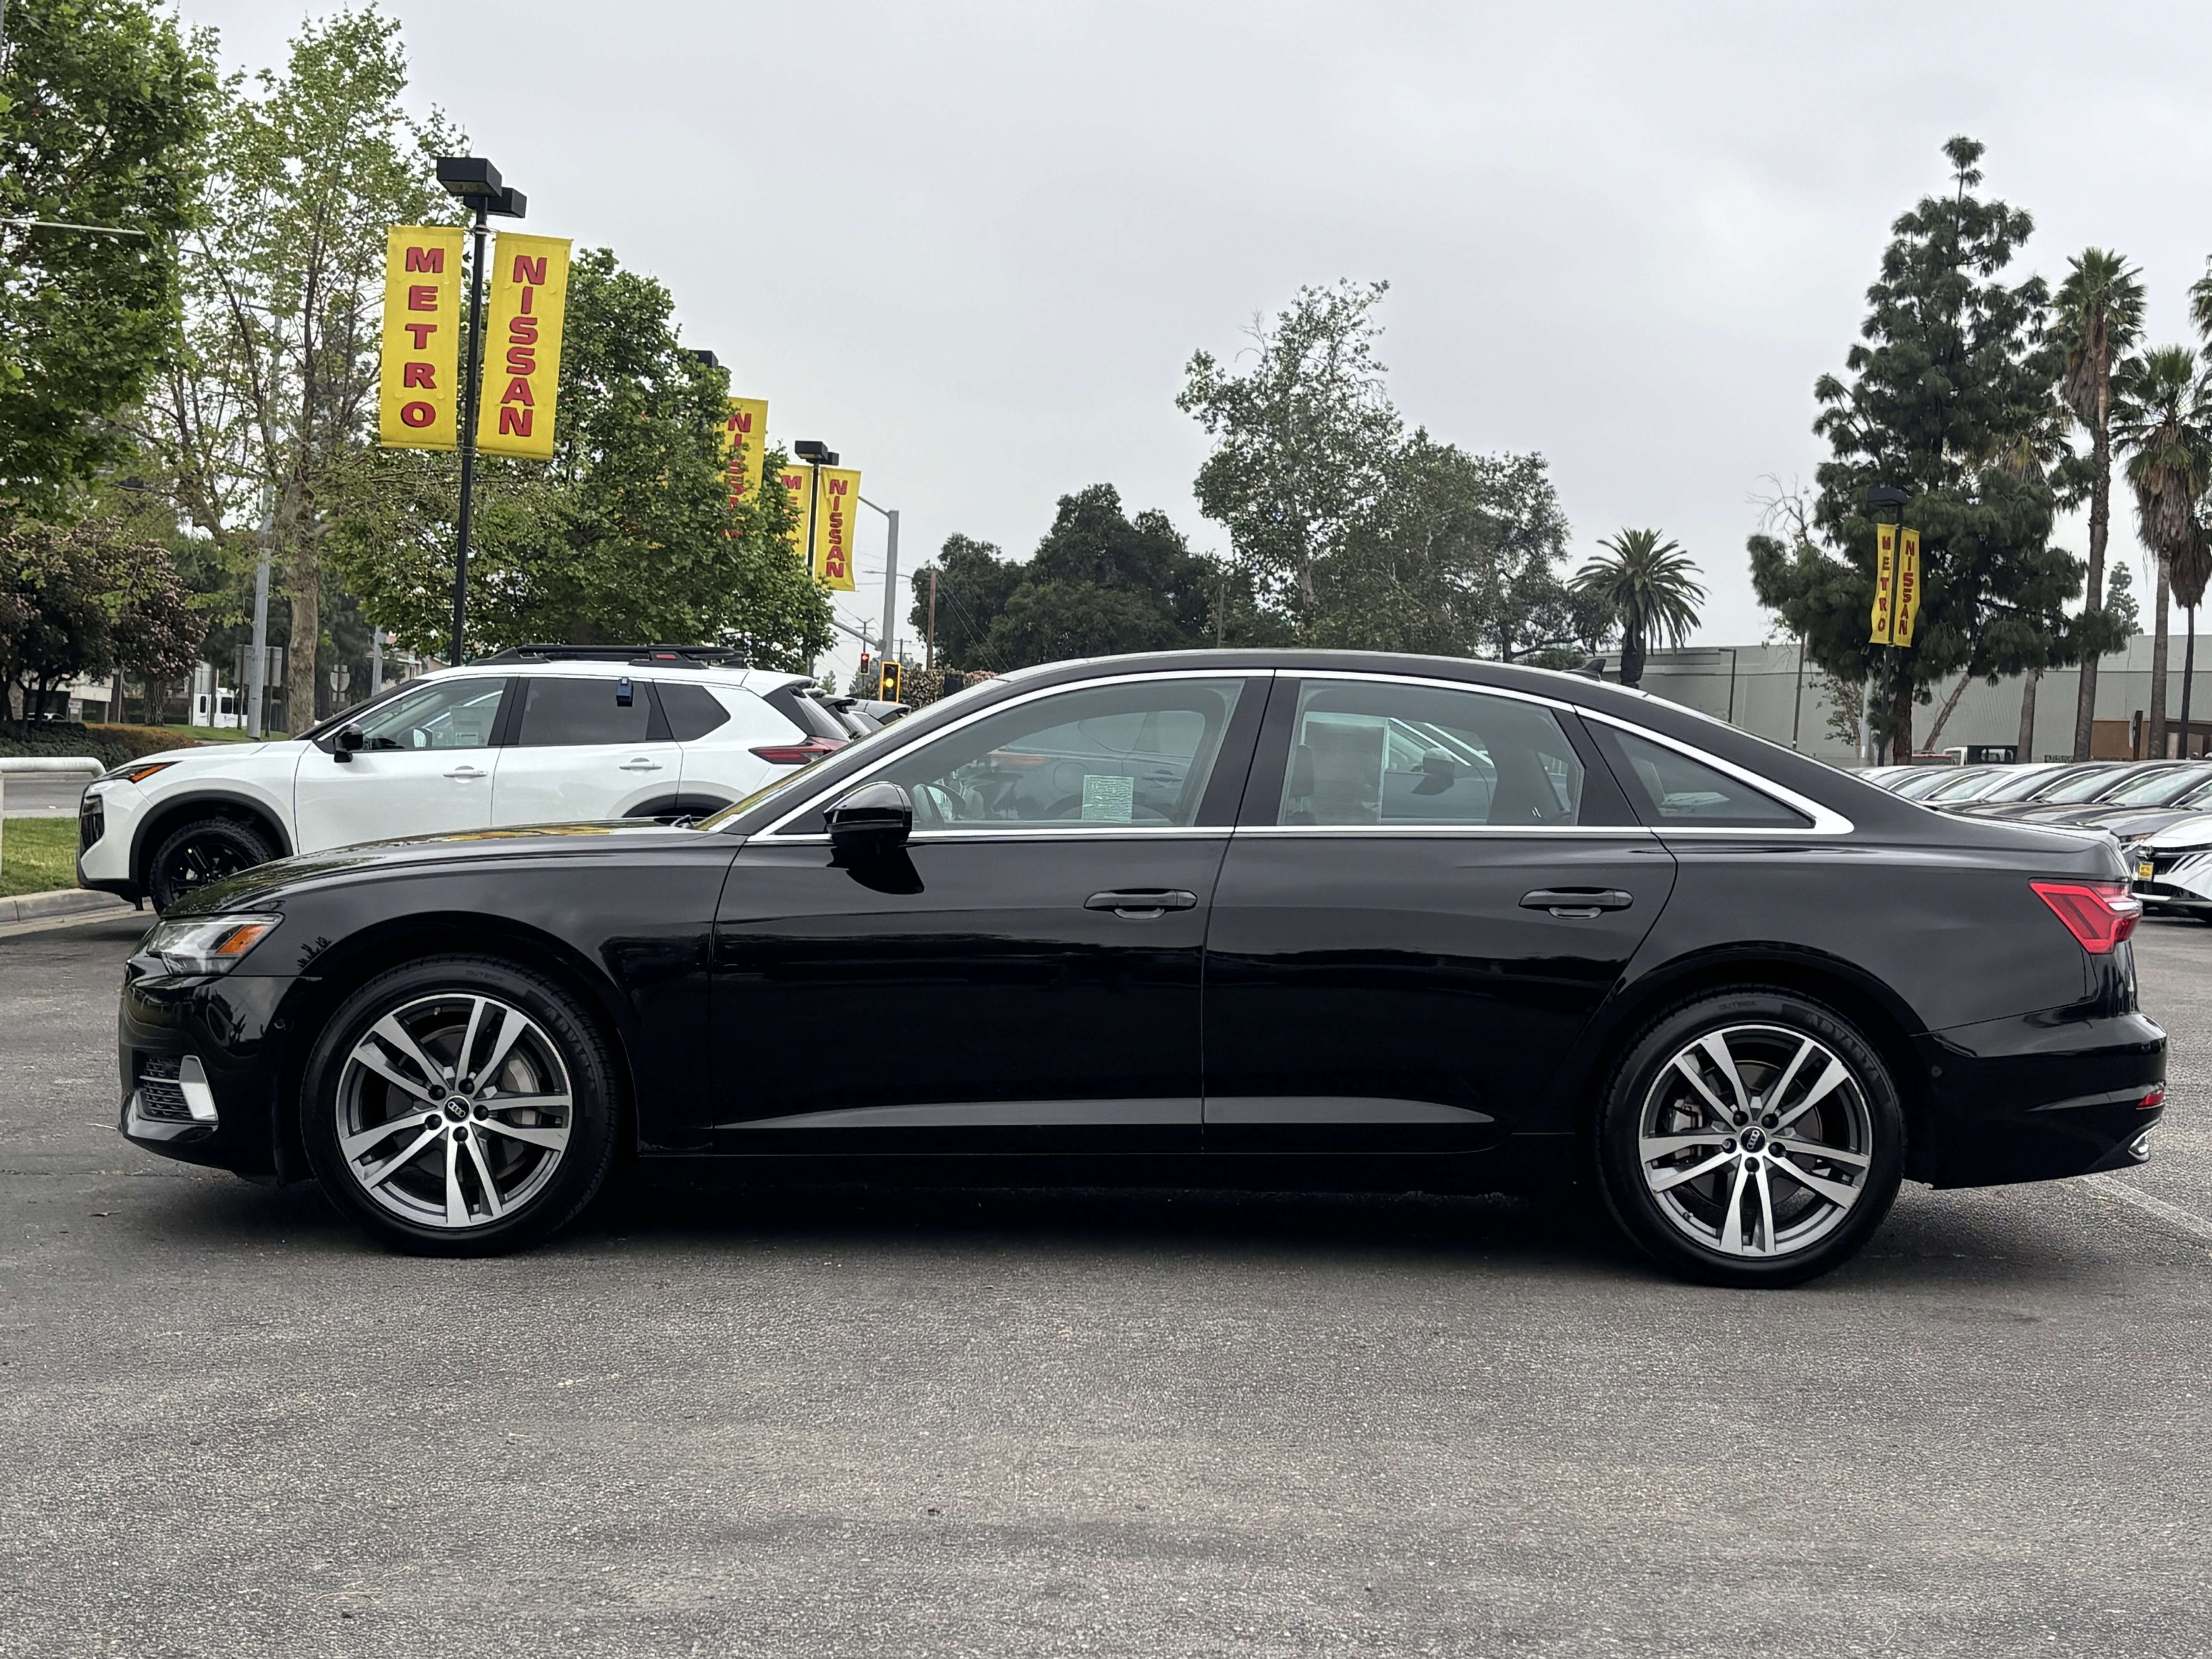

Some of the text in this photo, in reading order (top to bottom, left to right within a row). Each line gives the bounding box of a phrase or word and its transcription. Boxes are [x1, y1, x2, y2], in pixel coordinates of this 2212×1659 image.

[400, 247, 445, 428] METRO
[499, 255, 548, 437] NISSAN
[826, 479, 848, 578] NISSAN
[1877, 536, 1891, 632] METRO
[1898, 539, 1915, 635] NISSAN
